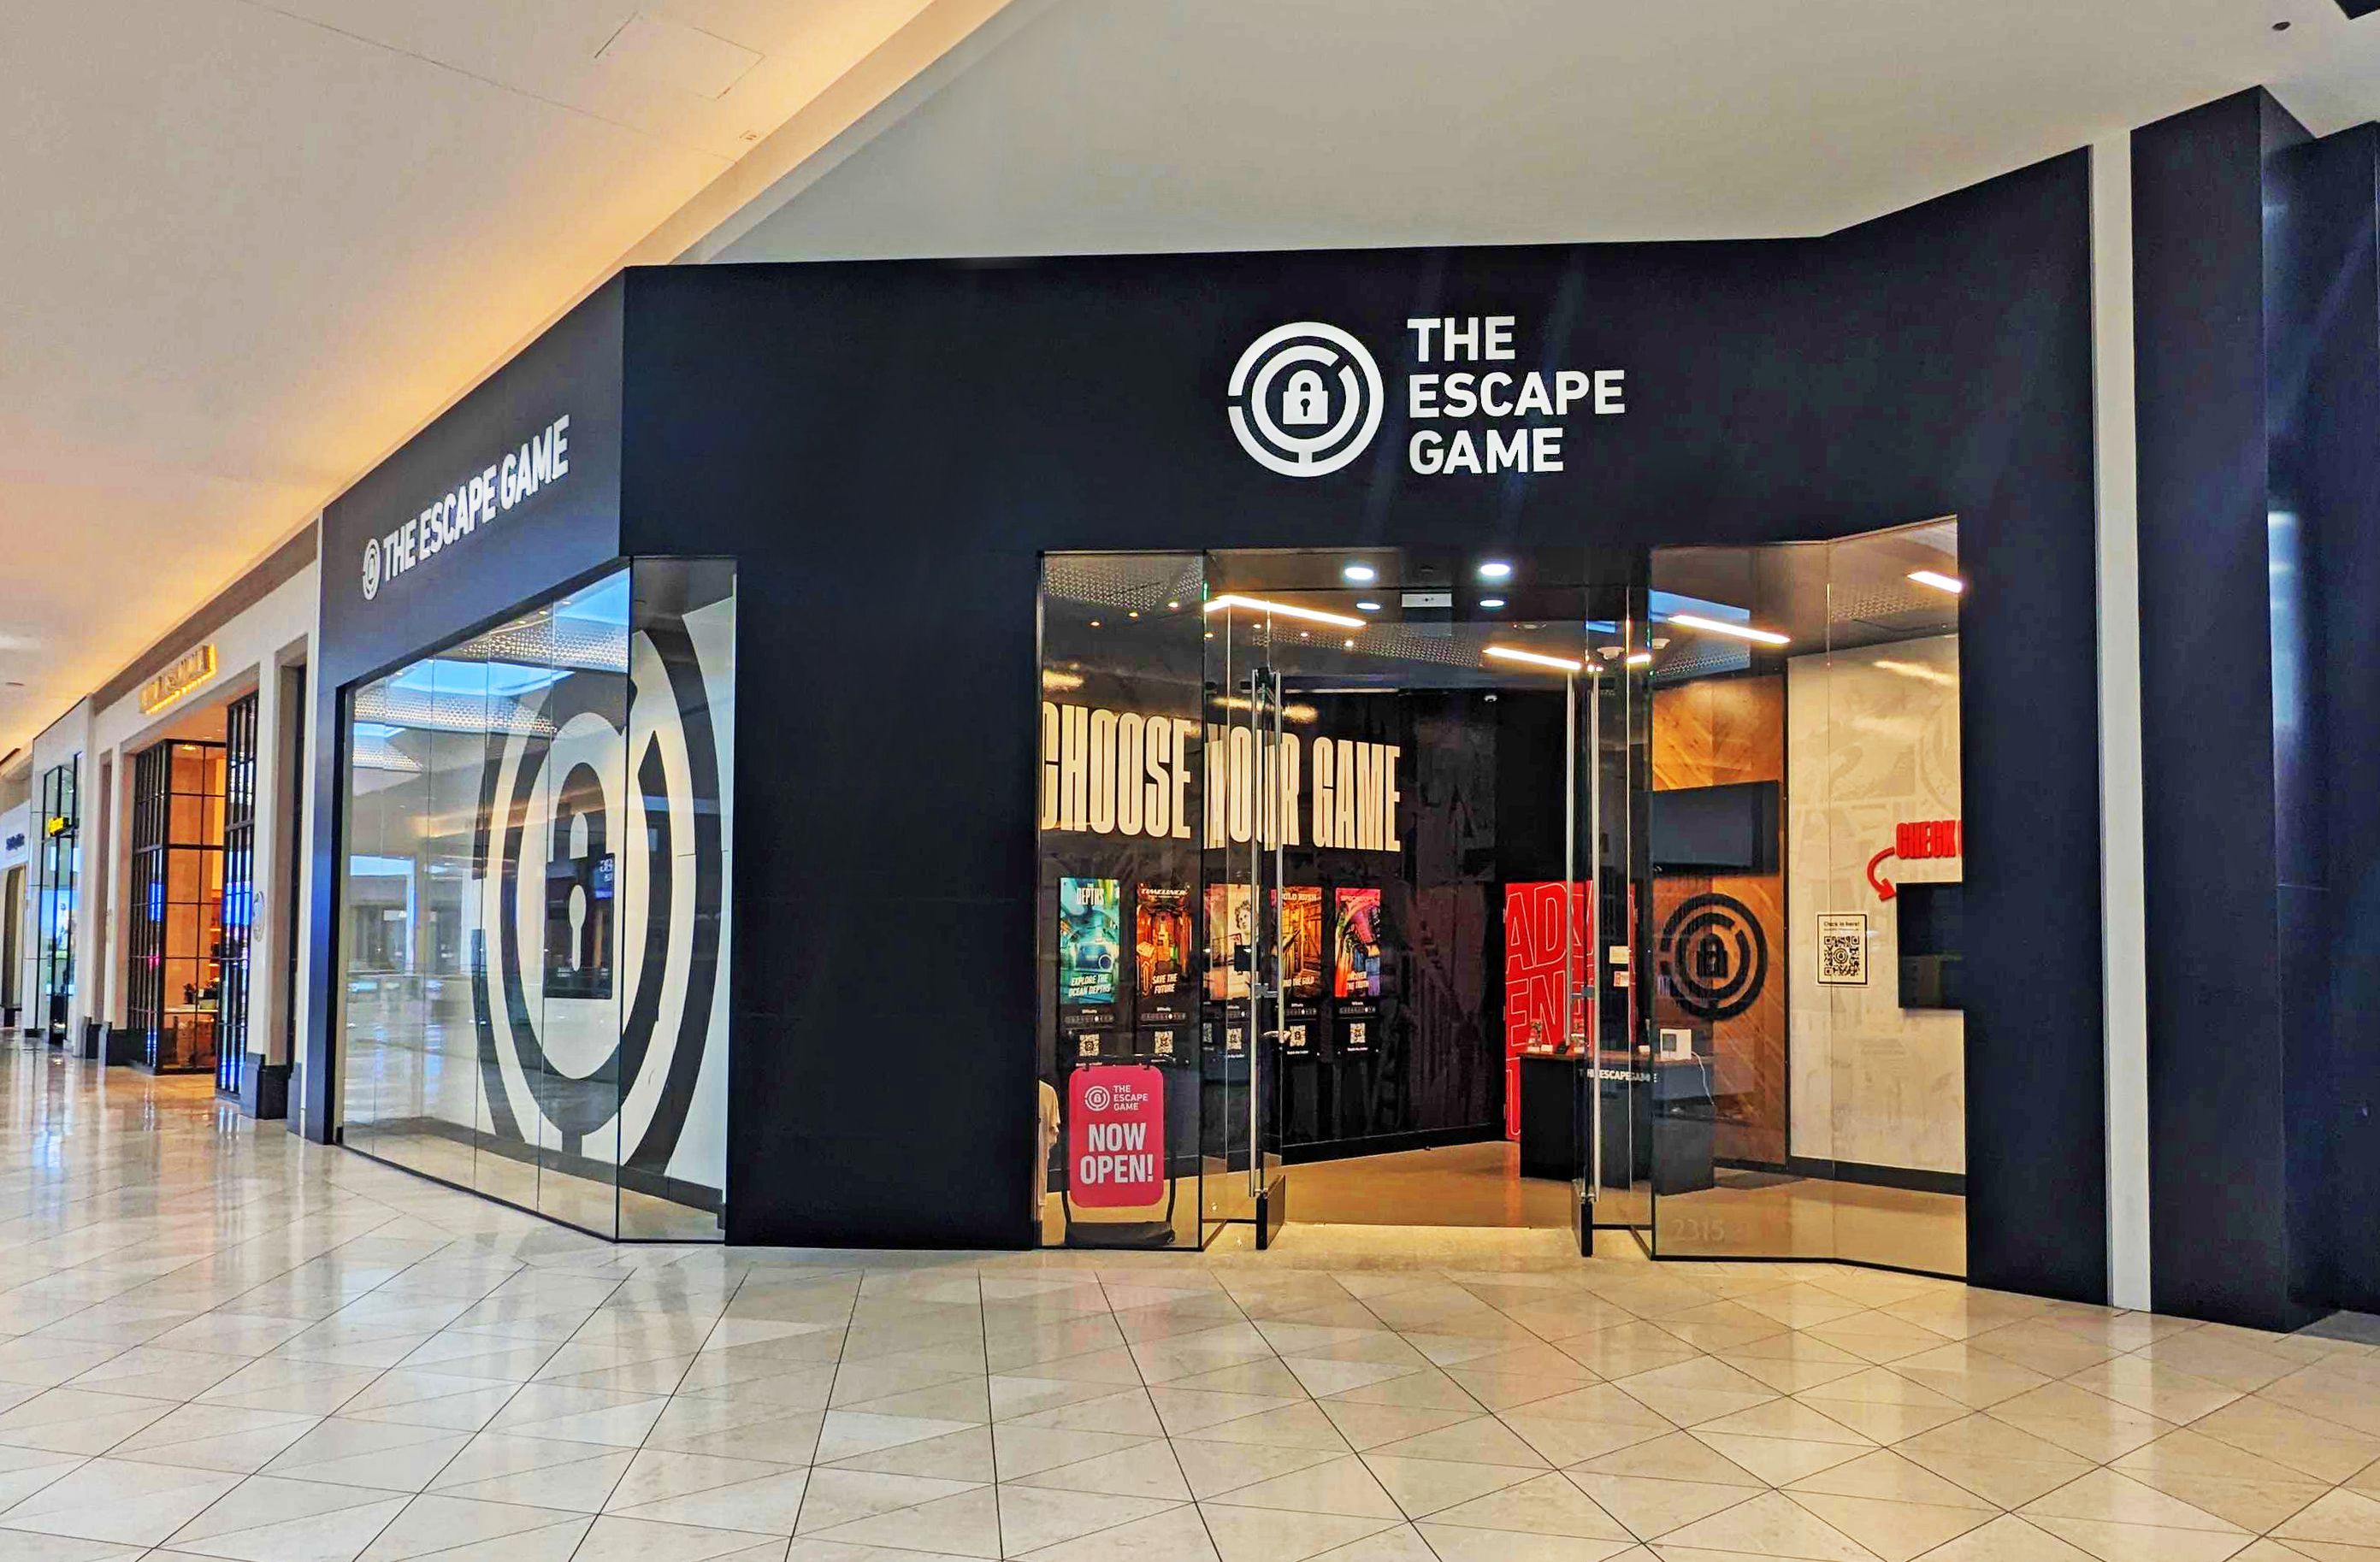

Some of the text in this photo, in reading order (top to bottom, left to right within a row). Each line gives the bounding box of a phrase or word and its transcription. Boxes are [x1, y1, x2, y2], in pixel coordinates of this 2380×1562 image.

[1408, 315, 1515, 363] THE
[1409, 369, 1626, 418] ESCAPE
[1409, 427, 1564, 474] GAME
[383, 414, 570, 581] THE ESCAPE GAME
[1042, 701, 1191, 839] CHOOSE
[1313, 736, 1401, 852] GAME
[1896, 820, 1956, 860] CHECK
[1076, 887, 1105, 905] DEPTHS
[1599, 1069, 1631, 1081] ESCAPE
[1113, 1093, 1149, 1102] ESCAPE
[1113, 1102, 1139, 1111] GAME
[1088, 1122, 1147, 1152] NOW
[1080, 1154, 1154, 1184] OPEN!
